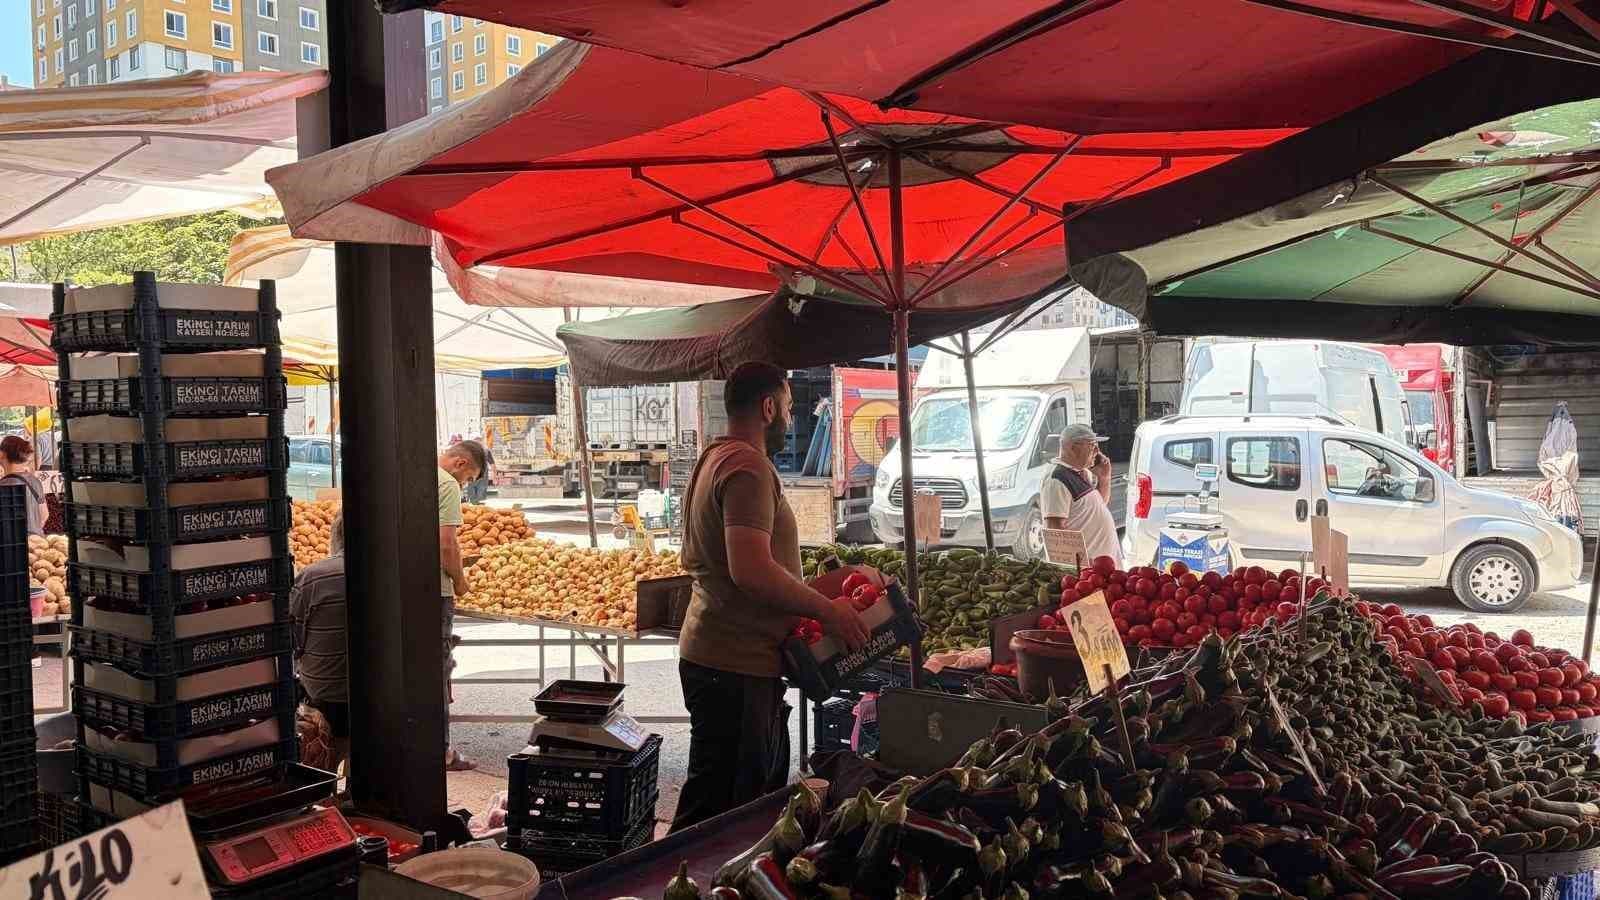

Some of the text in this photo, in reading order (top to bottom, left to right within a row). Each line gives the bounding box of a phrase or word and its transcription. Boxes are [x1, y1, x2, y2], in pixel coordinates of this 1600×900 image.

[216, 321, 251, 331] TARIM
[222, 385, 260, 395] TARIM
[225, 447, 262, 458] TARIM
[228, 508, 265, 520] TARIM
[231, 567, 267, 581] TARIM
[235, 692, 272, 708] TARIM
[237, 751, 273, 771] TARIM
